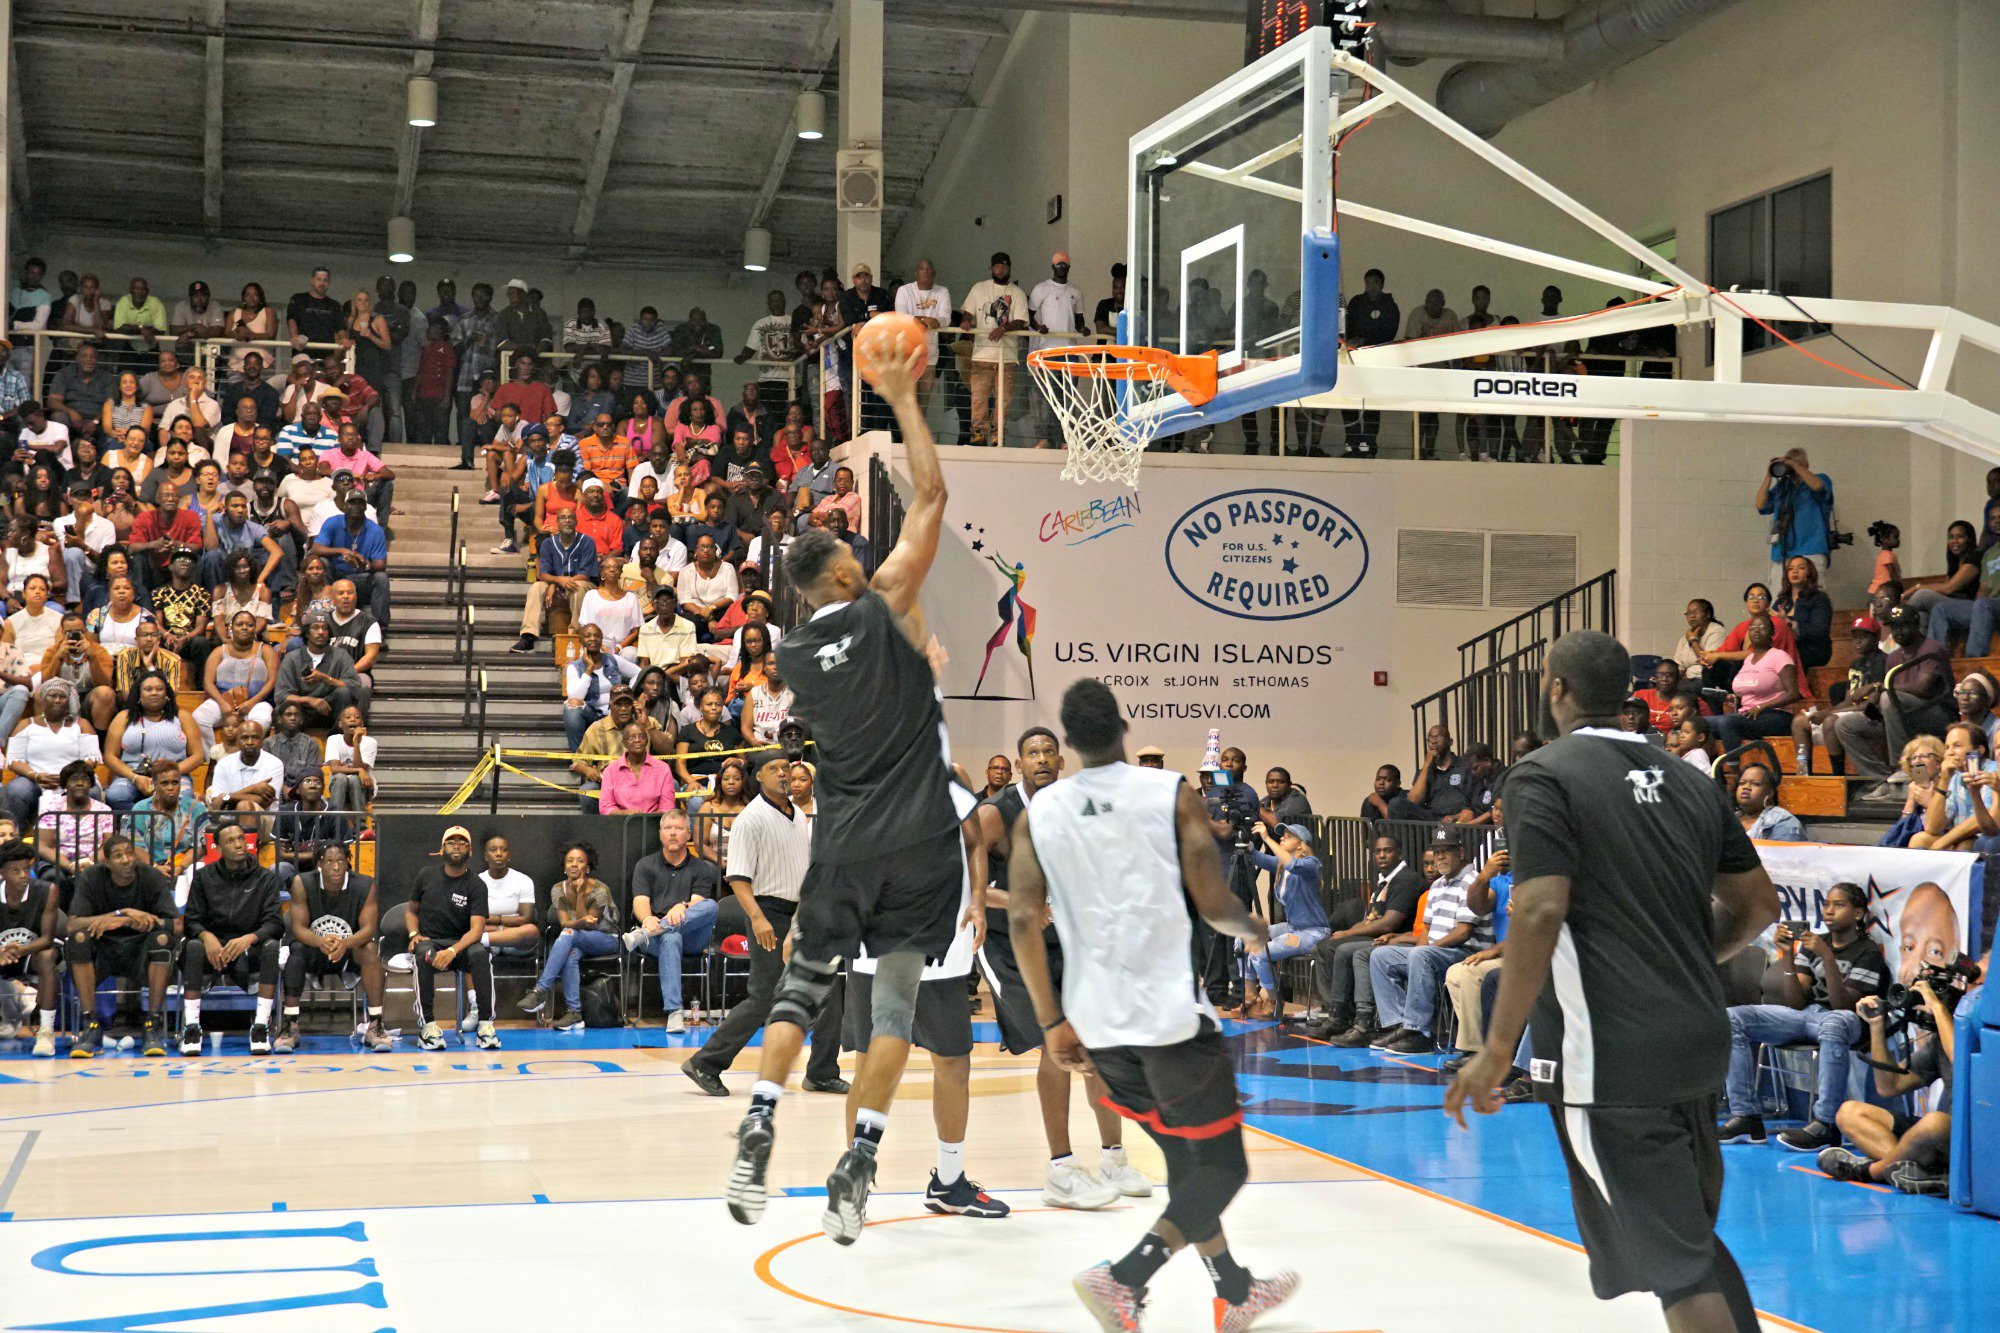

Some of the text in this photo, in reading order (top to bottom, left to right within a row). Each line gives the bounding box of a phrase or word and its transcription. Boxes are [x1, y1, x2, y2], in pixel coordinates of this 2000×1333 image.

[1038, 491, 1142, 543] CARIBBEAN
[1183, 499, 1354, 550] NO PASSPORT
[1222, 542, 1267, 551] FOR U.S.
[1222, 554, 1273, 564] CITIZENS
[1206, 571, 1330, 611] REQUIRED
[1055, 642, 1099, 663] U.S.
[1106, 643, 1200, 664] VIRGIN
[1213, 643, 1333, 665] ISLANDS
[1095, 675, 1149, 687] CROIX
[756, 708, 788, 723] HEAT
[1126, 703, 1271, 719] VISITUSVI.COM
